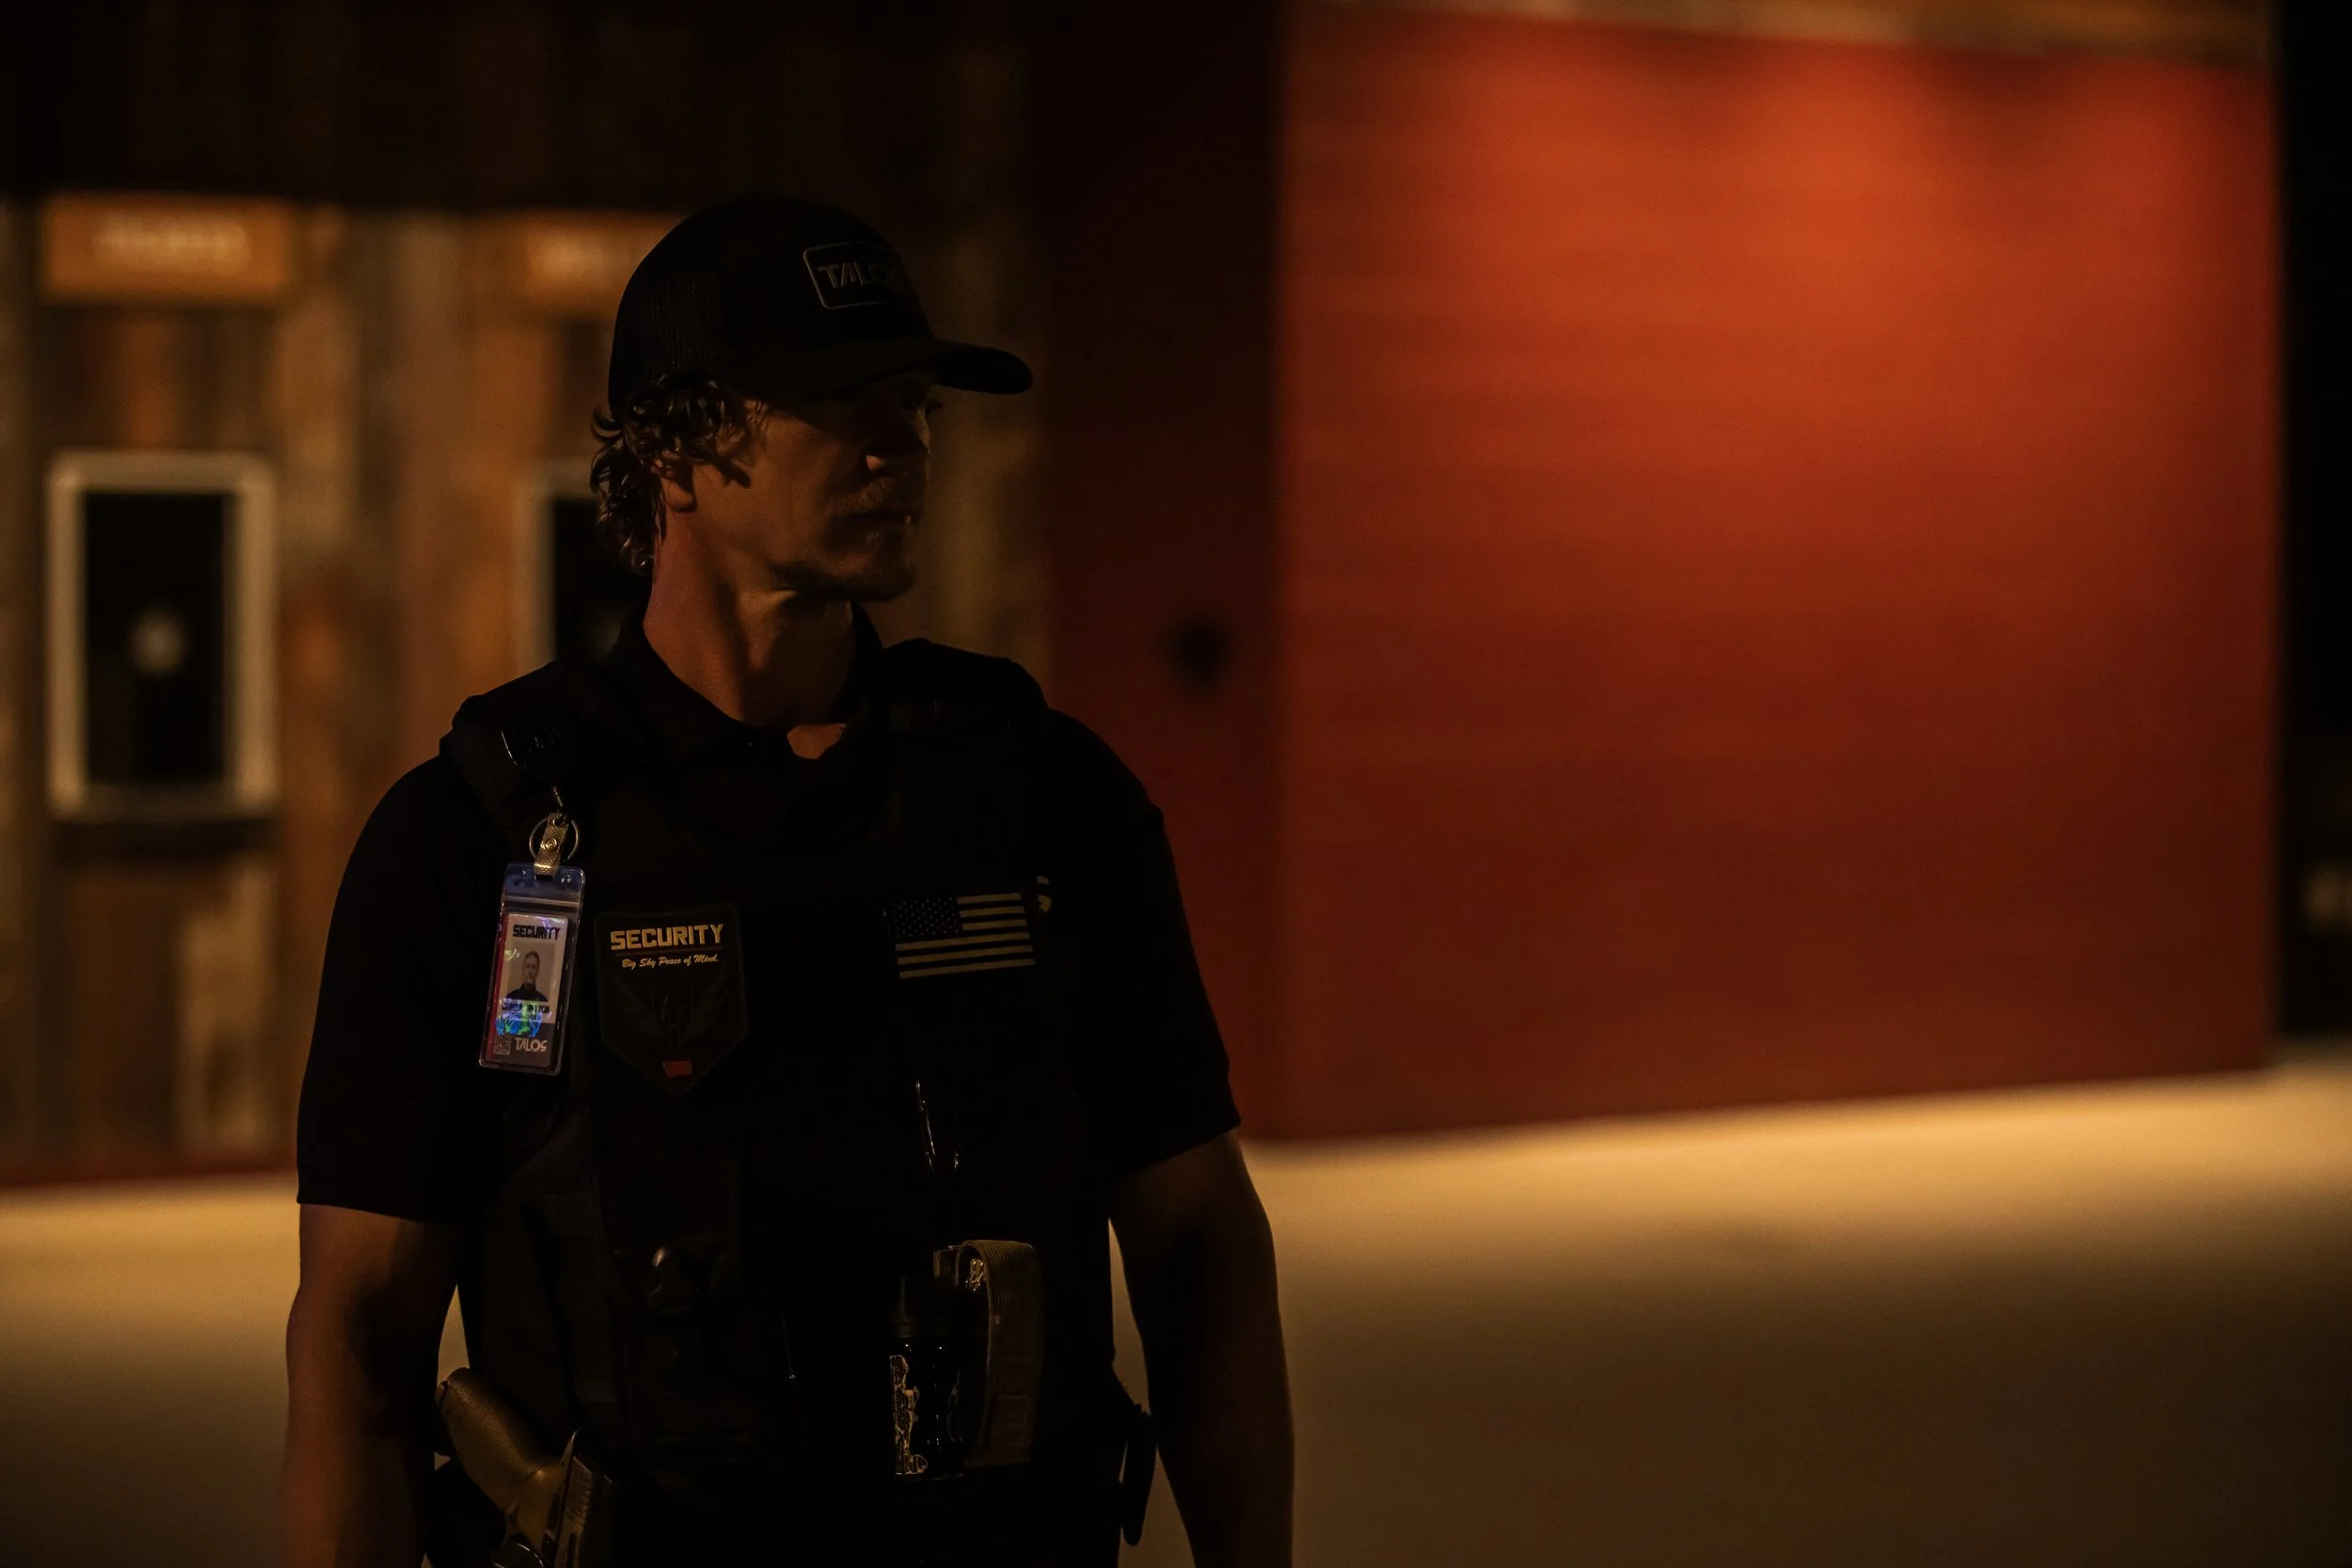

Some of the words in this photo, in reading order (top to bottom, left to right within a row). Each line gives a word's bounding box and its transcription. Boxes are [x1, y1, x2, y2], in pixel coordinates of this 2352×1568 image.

[513, 925, 561, 941] SECURITY
[611, 924, 723, 951] SECURITY
[622, 958, 637, 970] Big
[639, 958, 656, 969] Sky
[659, 956, 681, 967] Peace
[683, 955, 692, 967] of
[515, 1037, 548, 1053] TALOS
